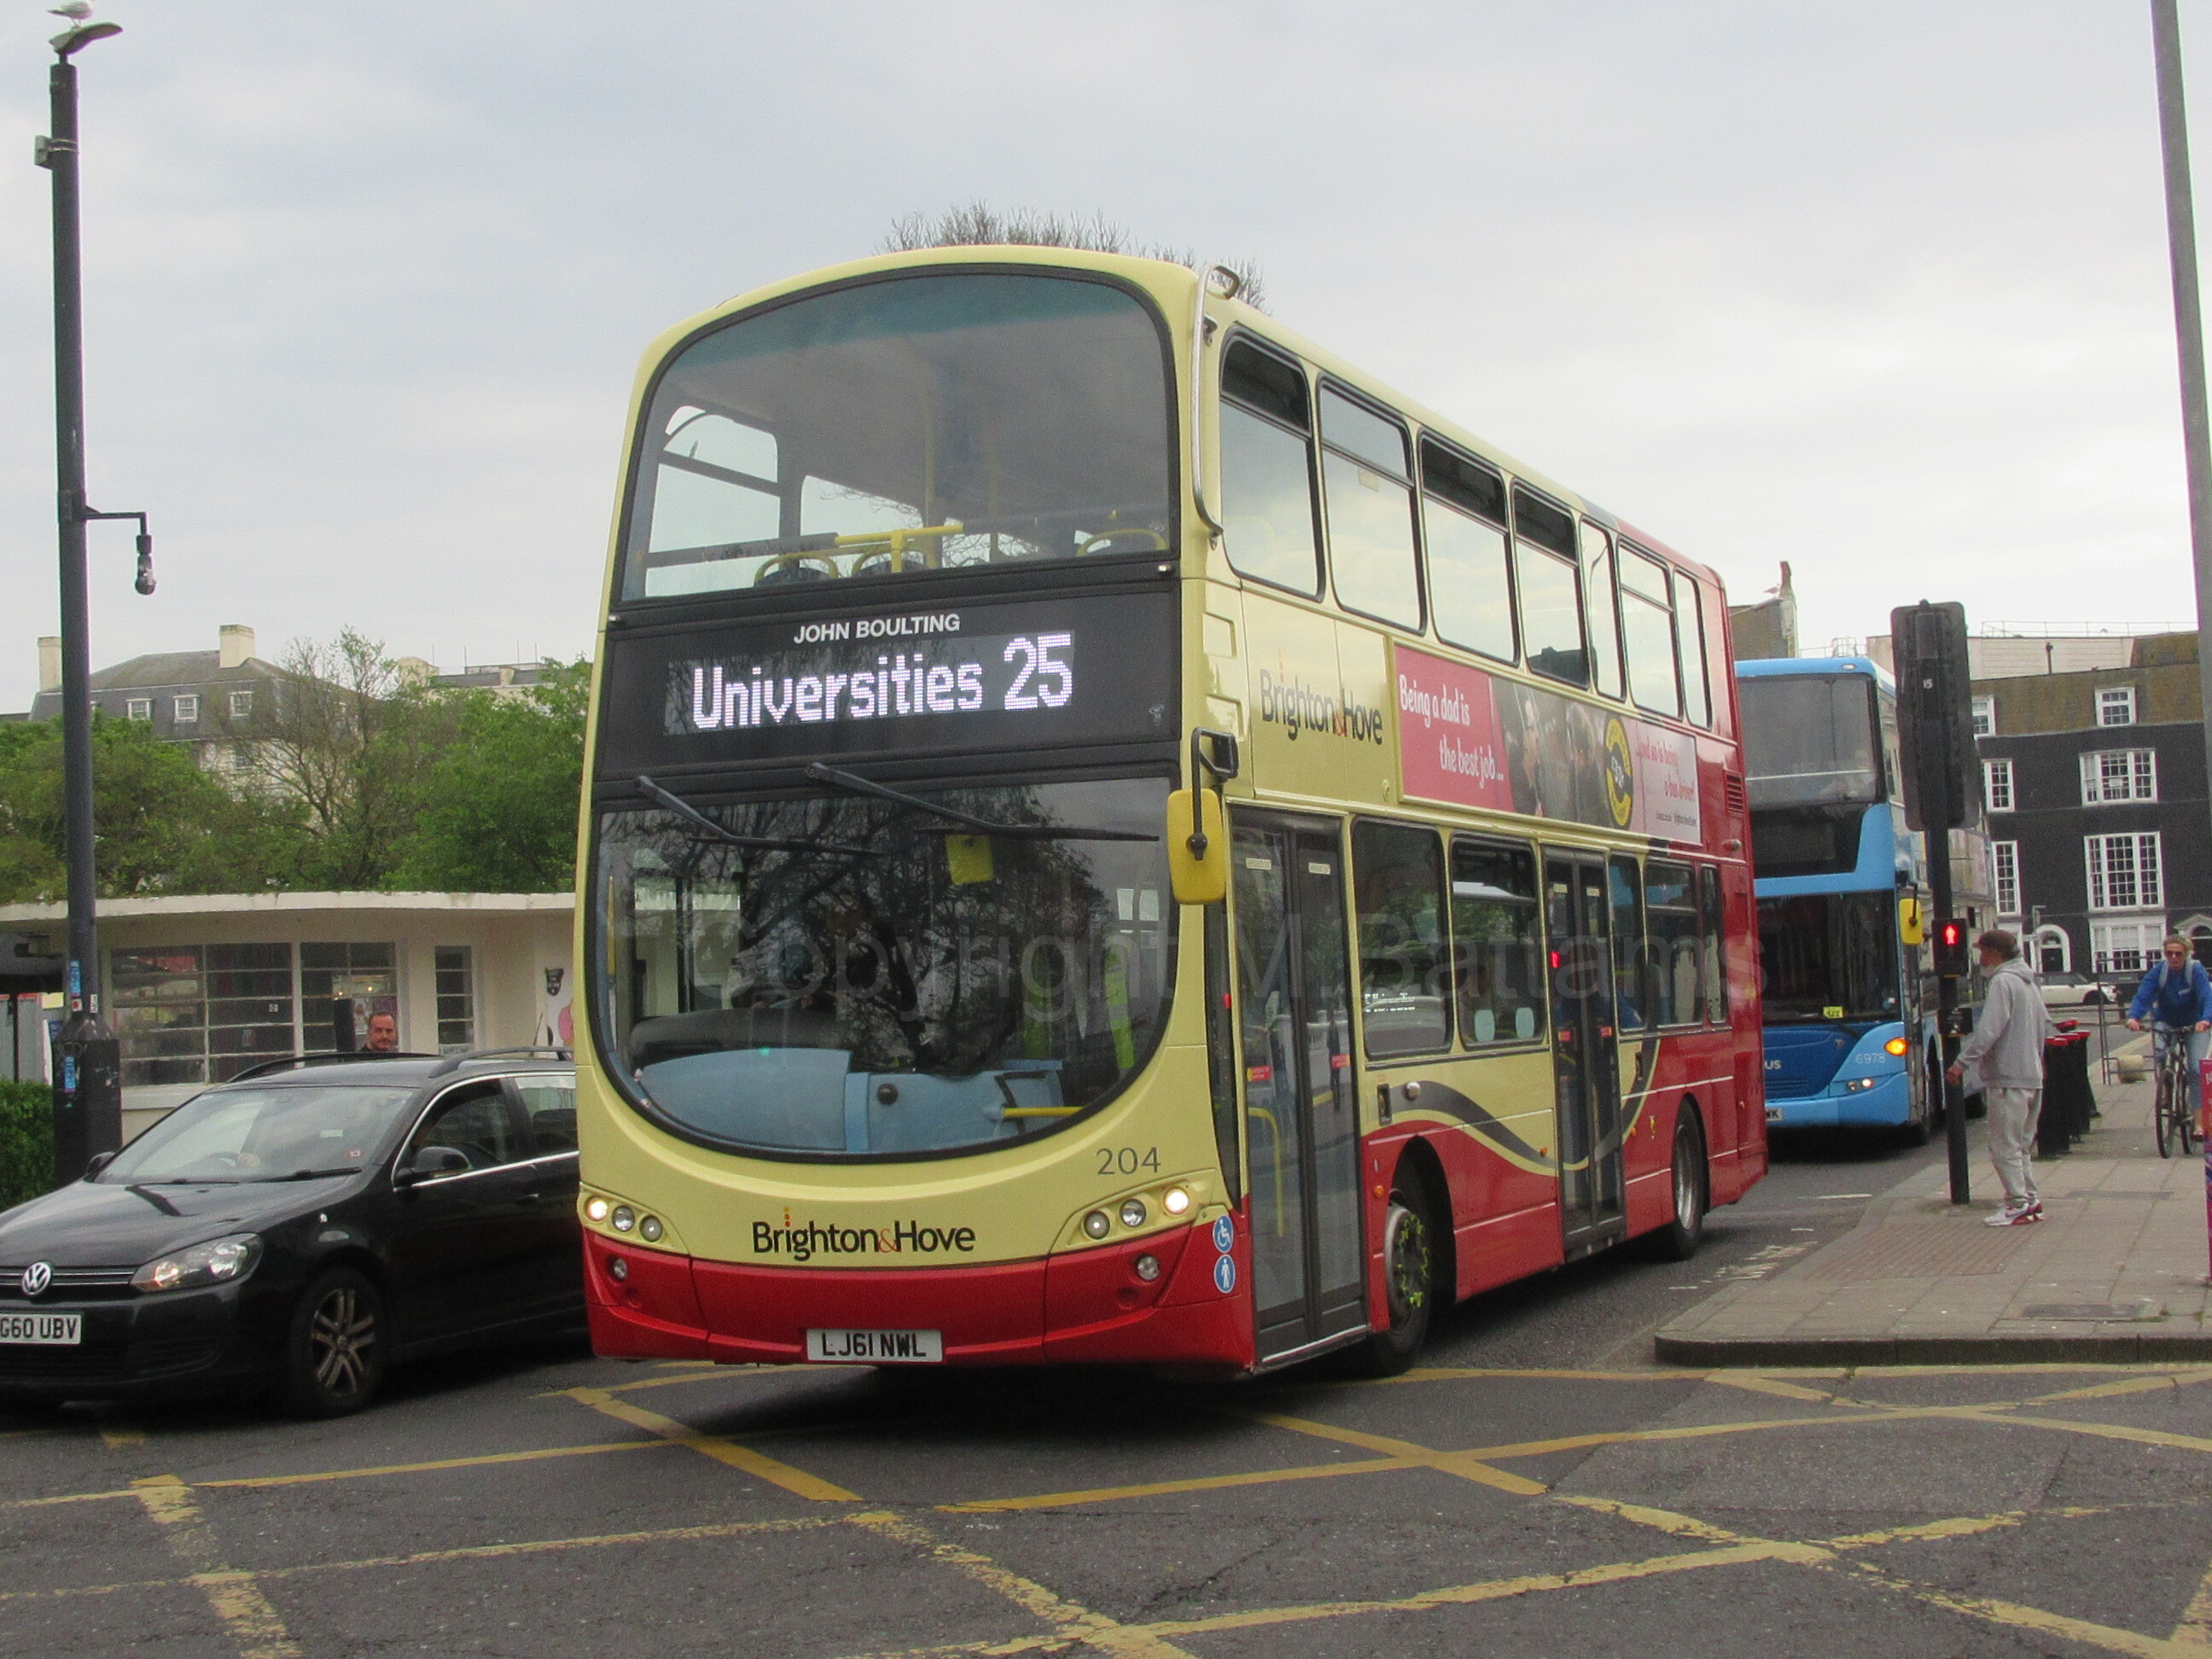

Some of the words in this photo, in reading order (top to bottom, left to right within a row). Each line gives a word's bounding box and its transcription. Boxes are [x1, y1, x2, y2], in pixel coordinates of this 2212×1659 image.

[794, 622, 850, 644] JOHN
[856, 613, 961, 639] BOULTING
[693, 654, 982, 730] Universities
[1004, 633, 1073, 710] 25
[1400, 673, 1430, 729] Being
[1432, 695, 1441, 719] a
[1441, 684, 1461, 725] dad
[1460, 692, 1470, 727] is
[1260, 666, 1383, 745] Brighton&Hove
[1439, 733, 1457, 773] the
[1457, 736, 1479, 777] best
[1096, 1146, 1161, 1175] 204
[752, 1217, 975, 1261] Brighton&Hove
[0, 1318, 34, 1339] G60
[39, 1318, 77, 1339] UBV
[822, 1332, 873, 1357] LJ61
[881, 1332, 927, 1358] NWL
